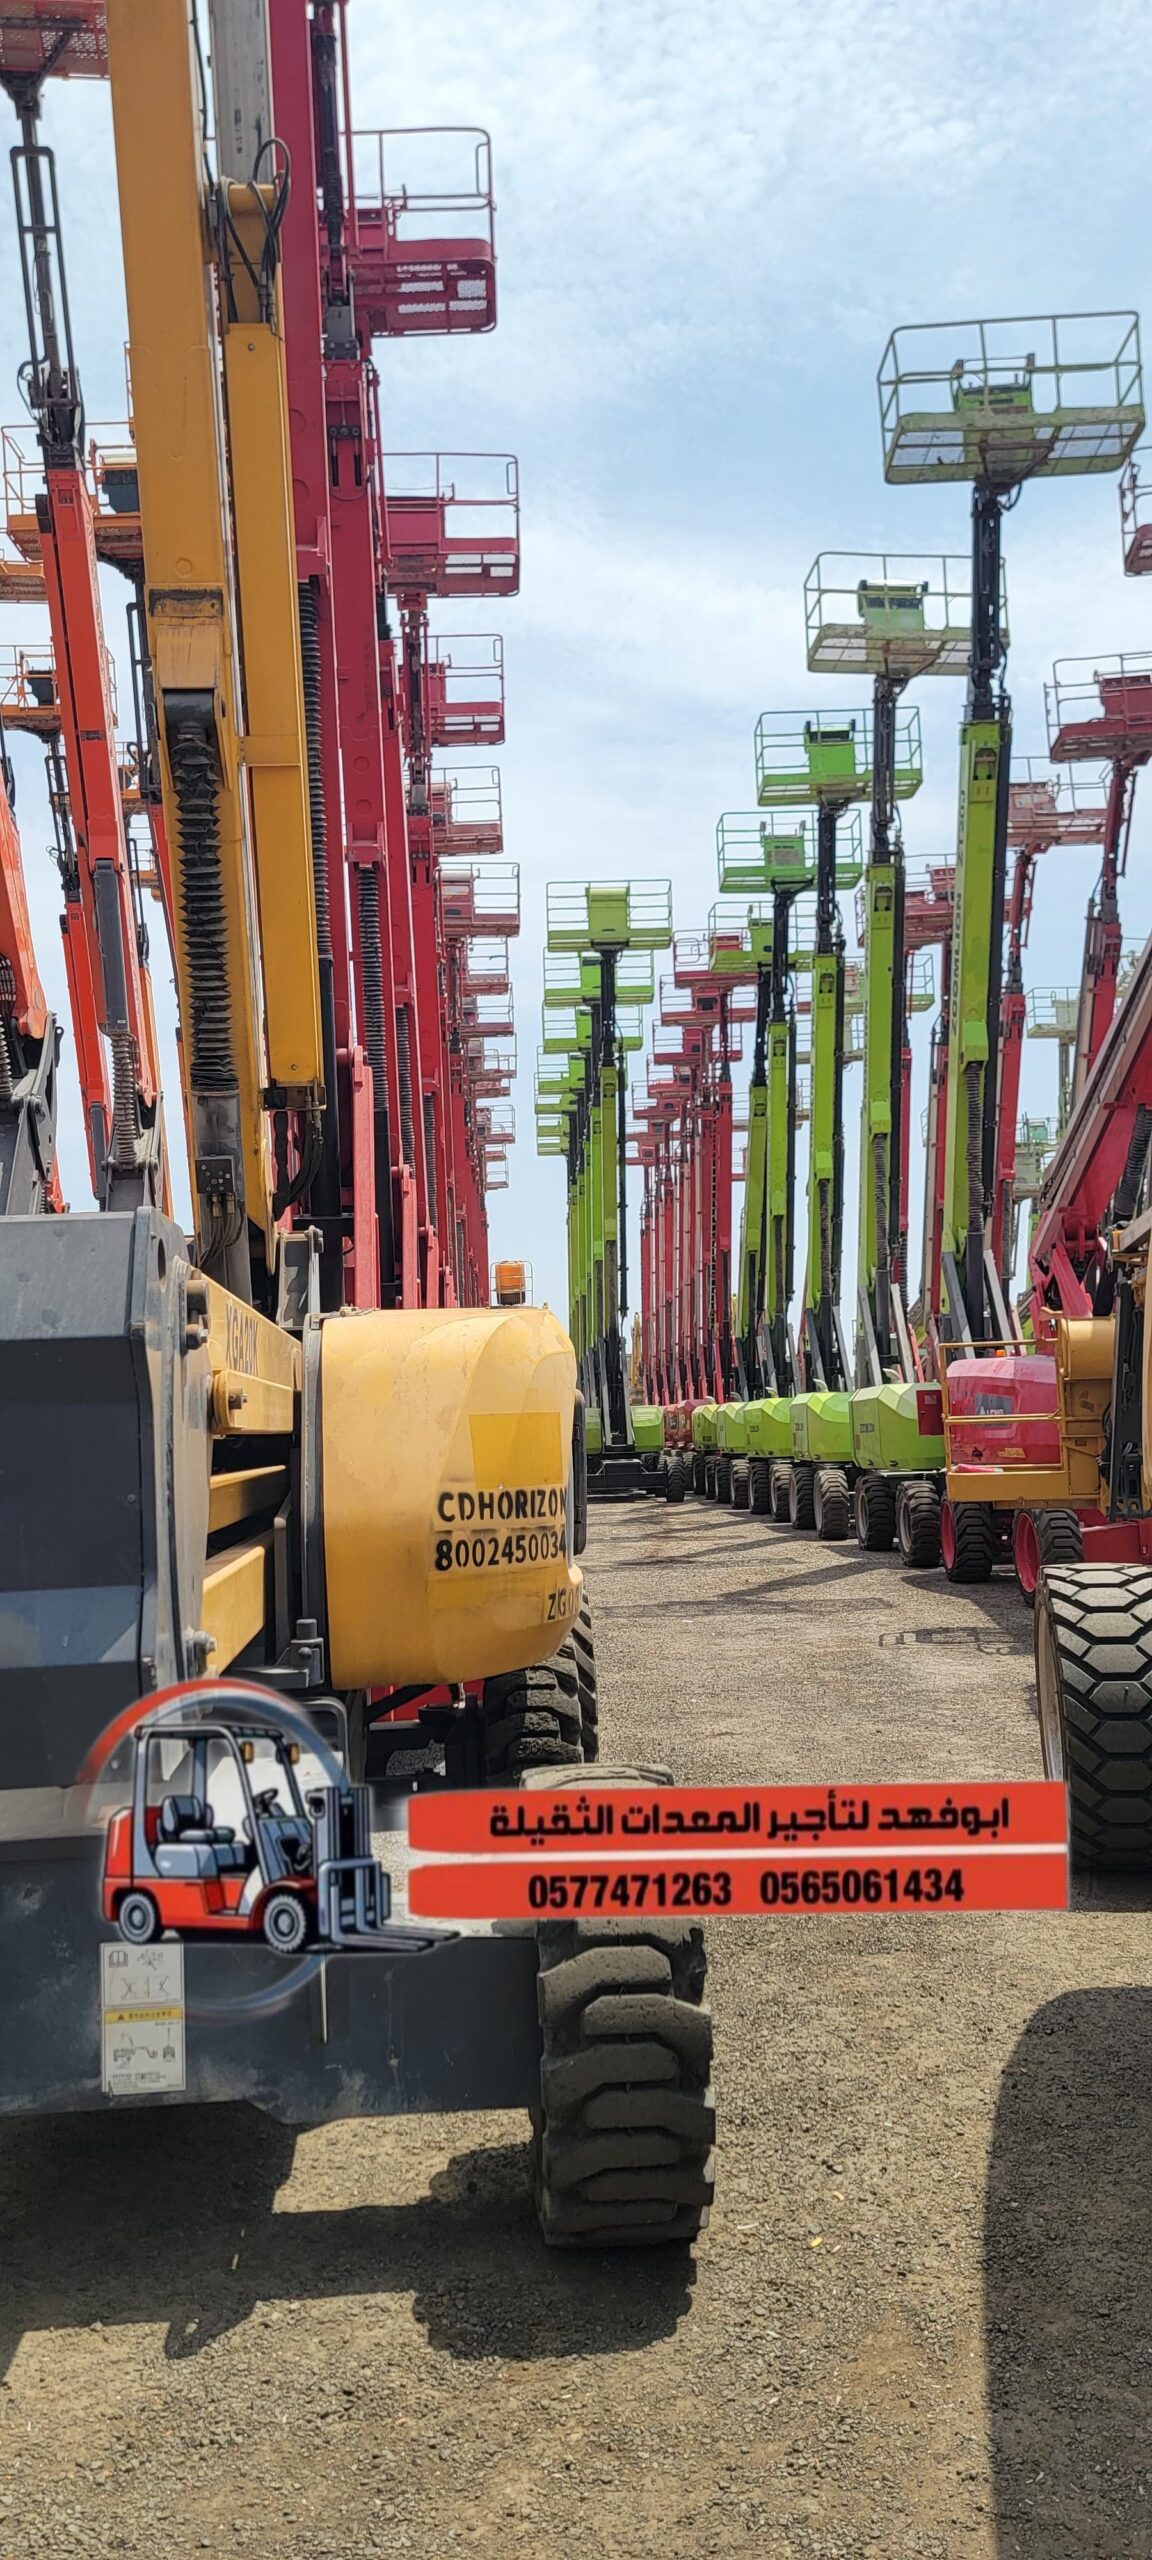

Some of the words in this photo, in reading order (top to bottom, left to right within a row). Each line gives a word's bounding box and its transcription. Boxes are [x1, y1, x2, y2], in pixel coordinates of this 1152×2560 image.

[951, 893, 962, 1037] ZOOMLION
[437, 1487, 567, 1522] CDHORIZON
[435, 1529, 567, 1571] 8002450034
